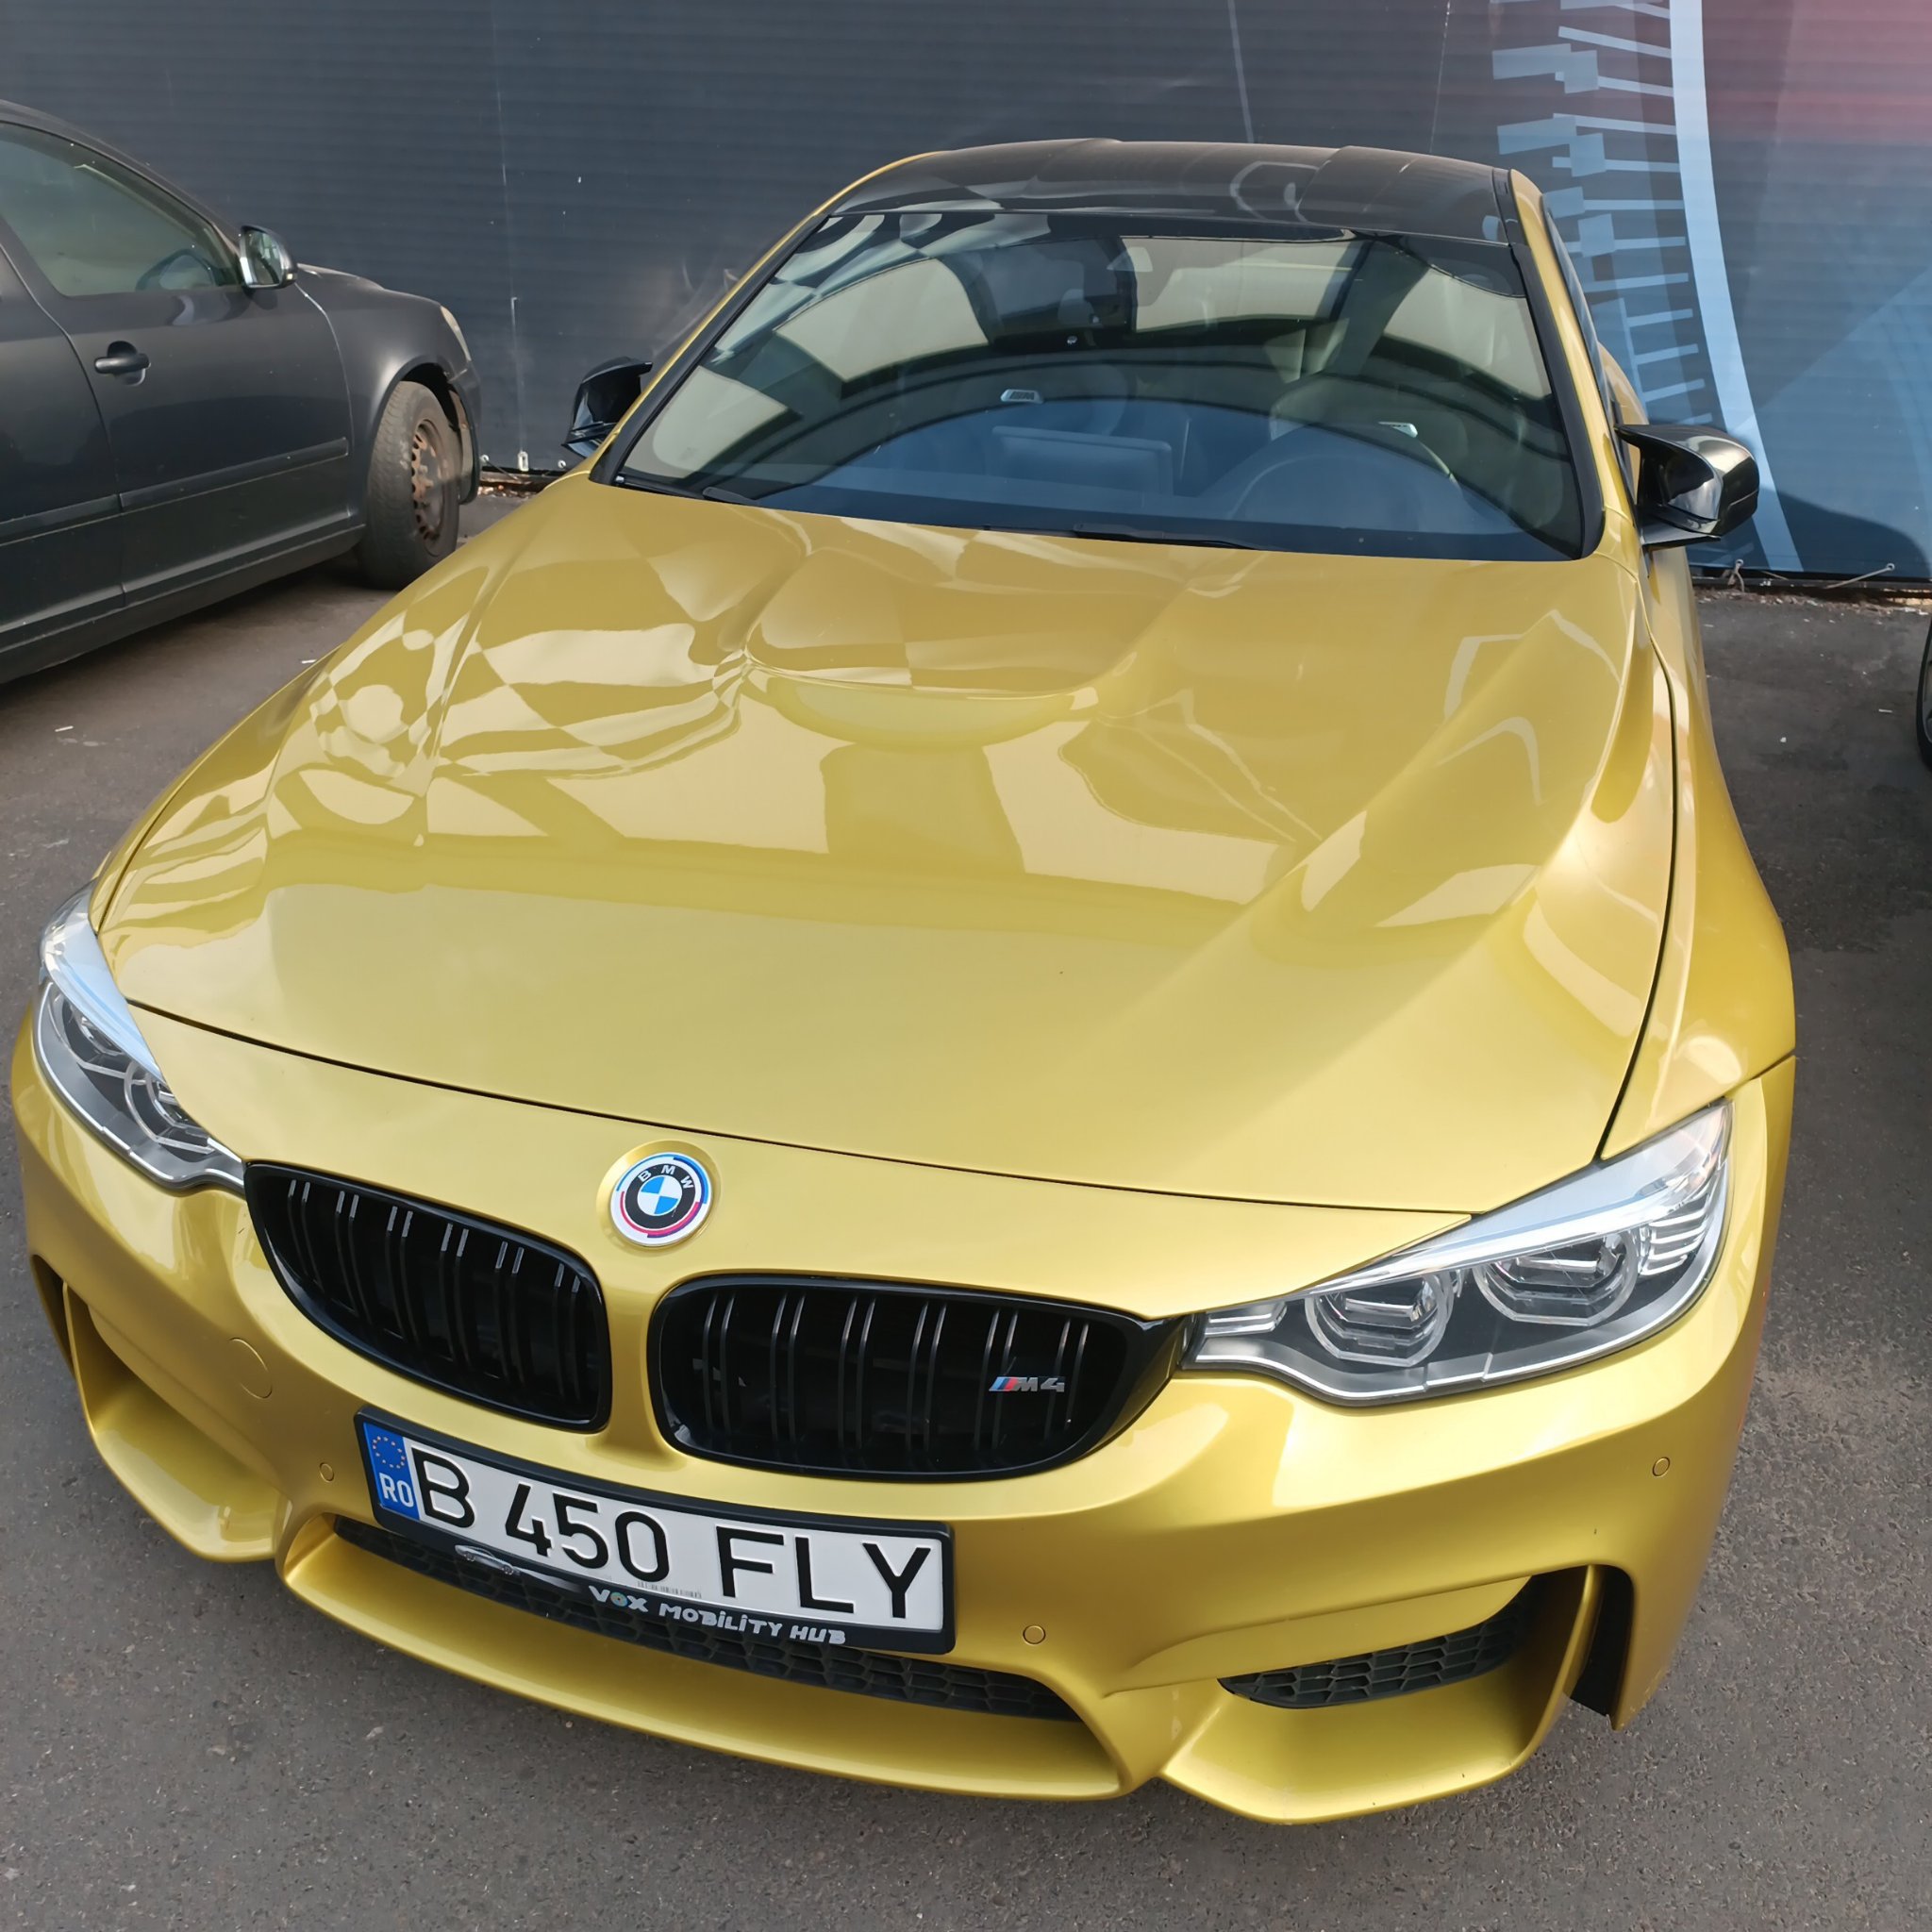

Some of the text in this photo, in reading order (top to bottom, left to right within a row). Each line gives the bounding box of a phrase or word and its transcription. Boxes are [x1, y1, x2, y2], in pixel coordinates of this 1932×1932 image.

[638, 1164, 694, 1189] BMW
[1009, 1376, 1065, 1392] M4
[379, 1472, 414, 1507] RO
[411, 1447, 932, 1619] B 450 FLY
[589, 1585, 846, 1645] VOX MOBILITY HUB
